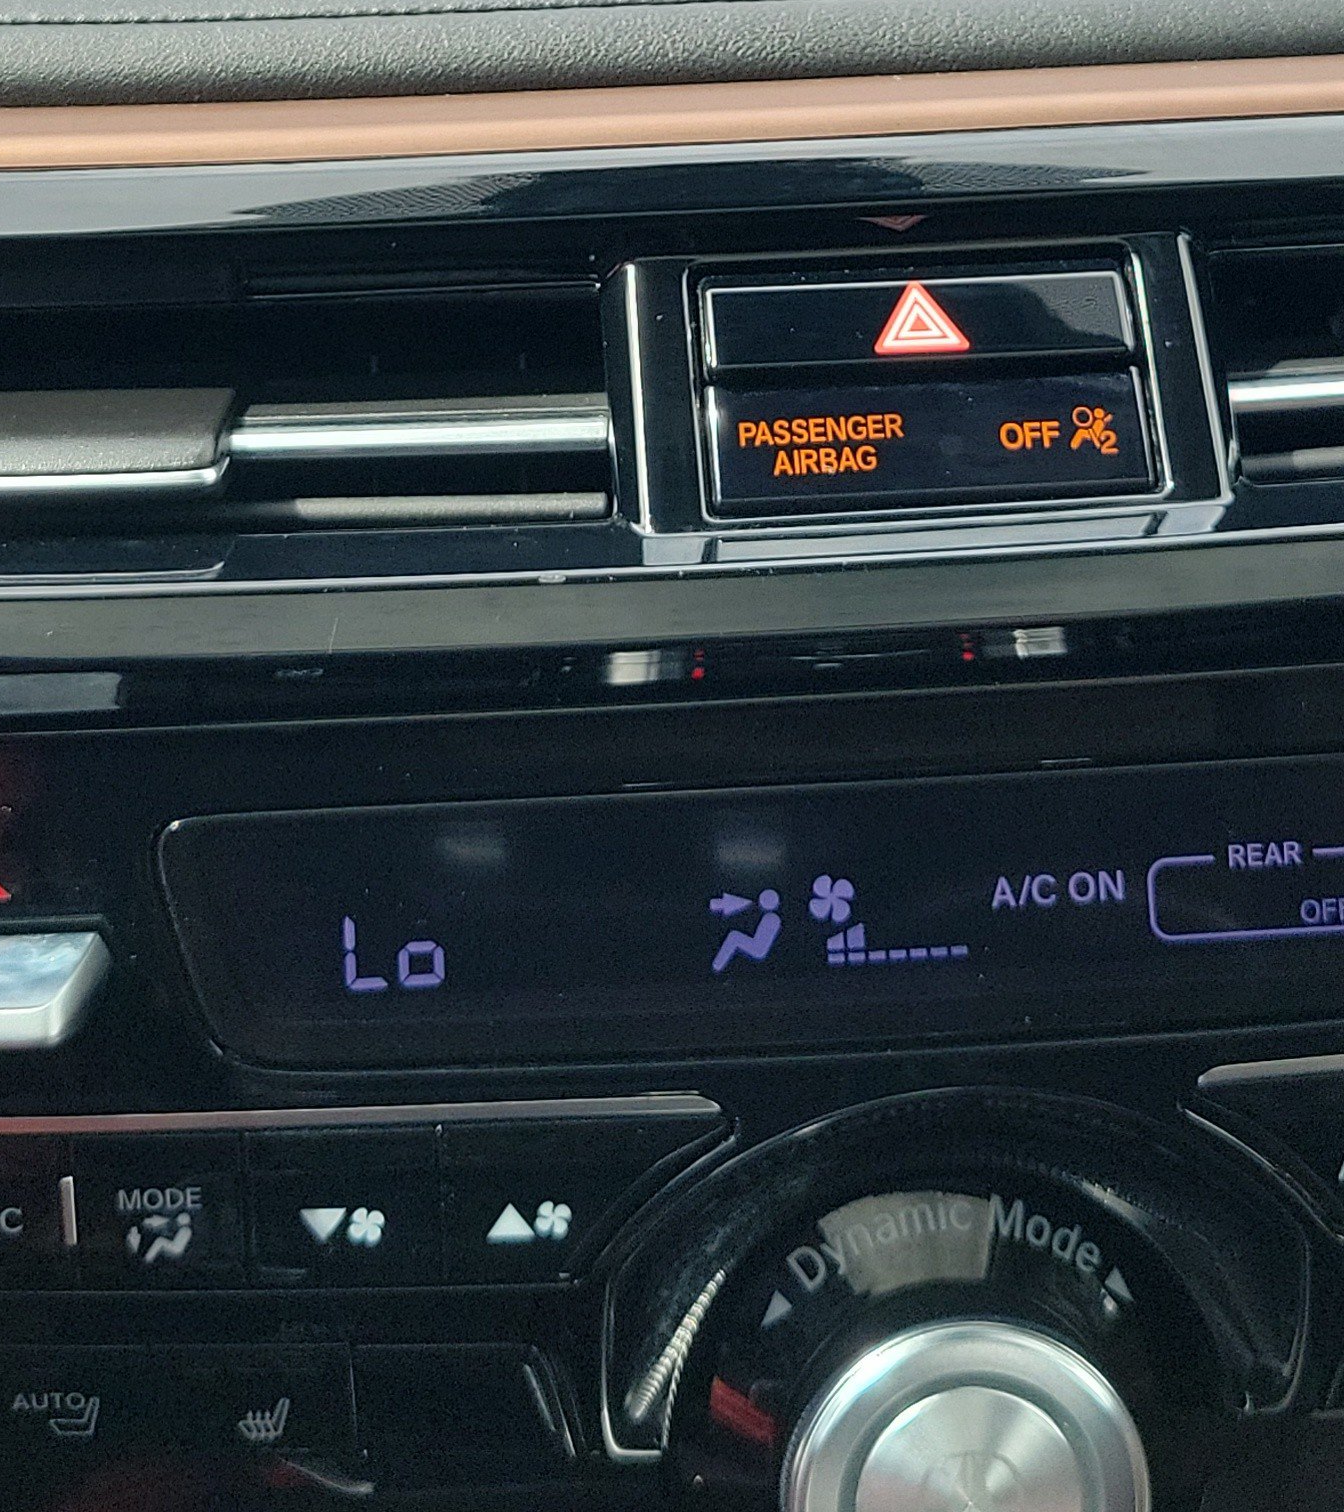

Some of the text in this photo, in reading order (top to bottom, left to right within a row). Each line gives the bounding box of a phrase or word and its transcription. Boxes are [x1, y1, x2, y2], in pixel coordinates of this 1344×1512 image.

[738, 413, 904, 447] PASSENGER
[999, 420, 1060, 451] OFF
[773, 445, 878, 477] AIRBAG
[1228, 842, 1303, 868] REAR
[992, 870, 1125, 908] A/C ON
[343, 916, 445, 989] Lo
[118, 1187, 202, 1211] MODE
[786, 1194, 1102, 1289] Dynamic Mode
[12, 1392, 86, 1412] AUTO
